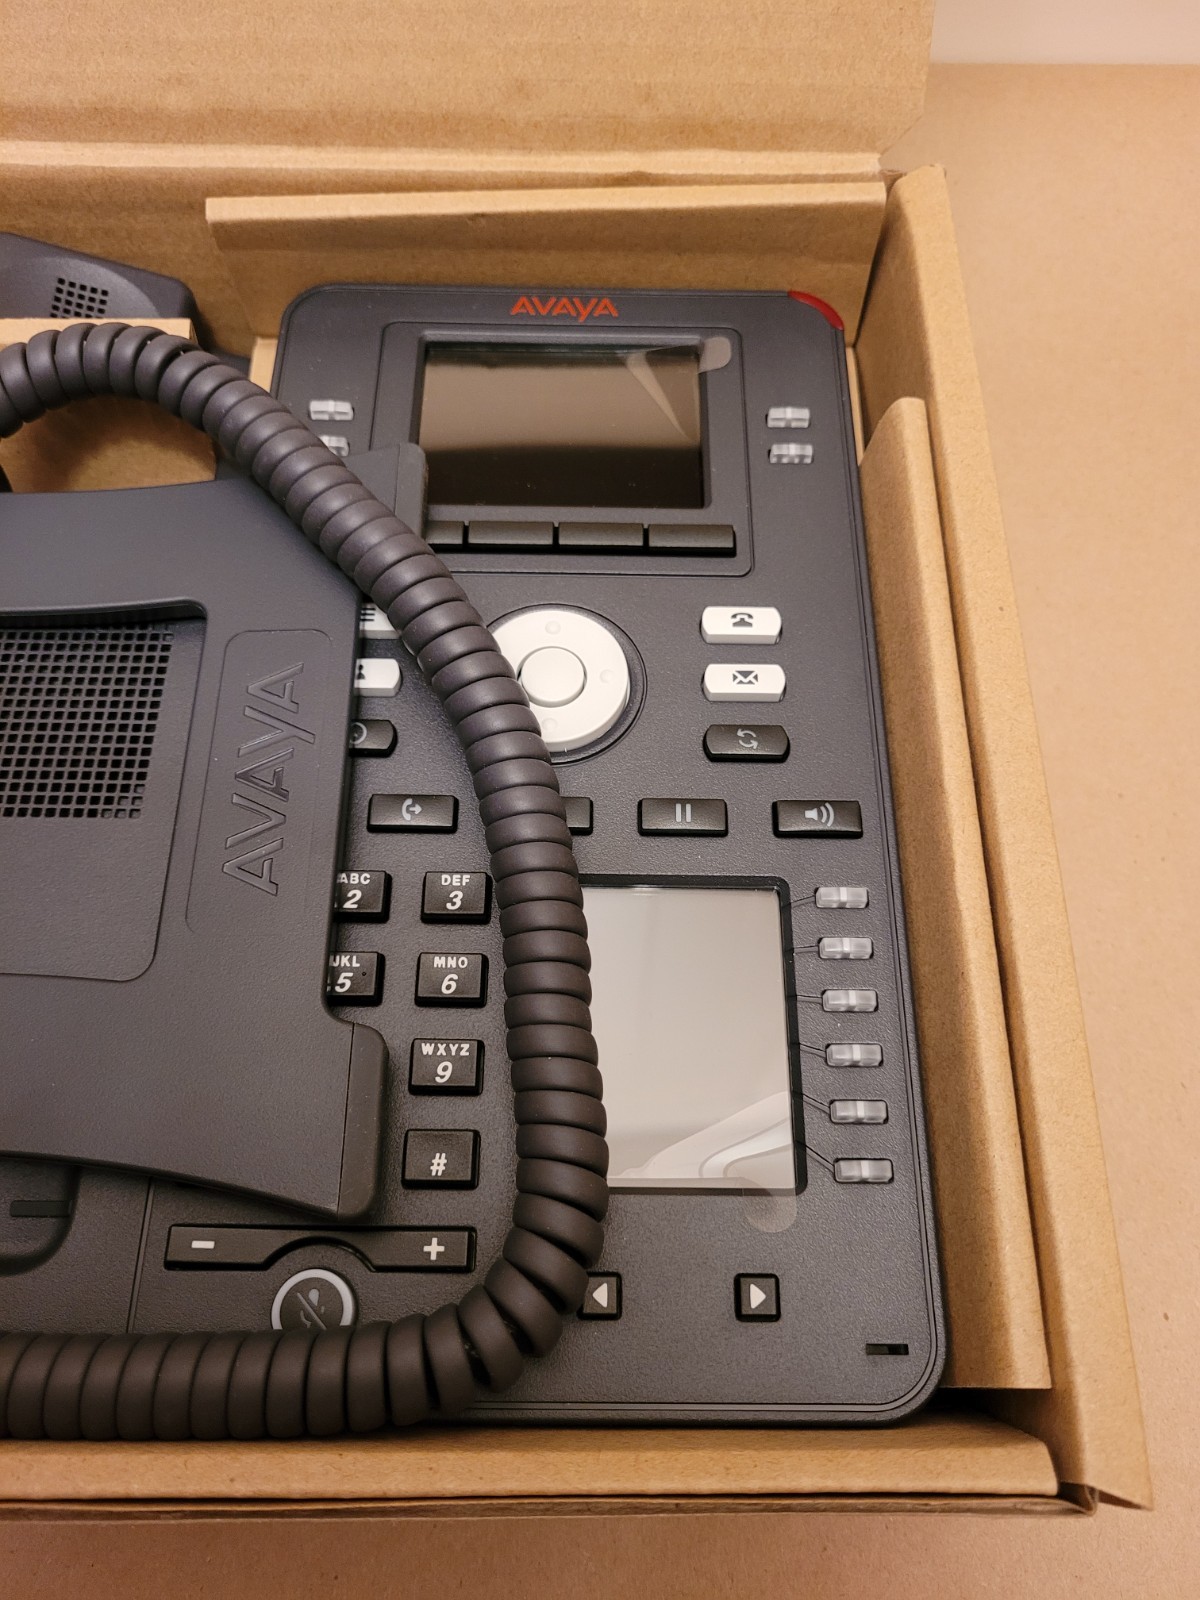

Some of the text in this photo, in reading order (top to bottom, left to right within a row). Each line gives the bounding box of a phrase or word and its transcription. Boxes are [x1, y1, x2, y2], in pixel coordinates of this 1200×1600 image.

[511, 296, 618, 322] AVAYA
[222, 661, 316, 897] AVAYA
[339, 872, 371, 885] ABC
[441, 874, 471, 886] DEF
[342, 889, 362, 909] 2
[445, 890, 464, 910] 3
[433, 956, 468, 969] MNO
[334, 972, 354, 993] 5
[441, 973, 459, 995] 6
[421, 1042, 470, 1056] WXYZ
[434, 1060, 453, 1083] 9
[430, 1152, 448, 1177] #
